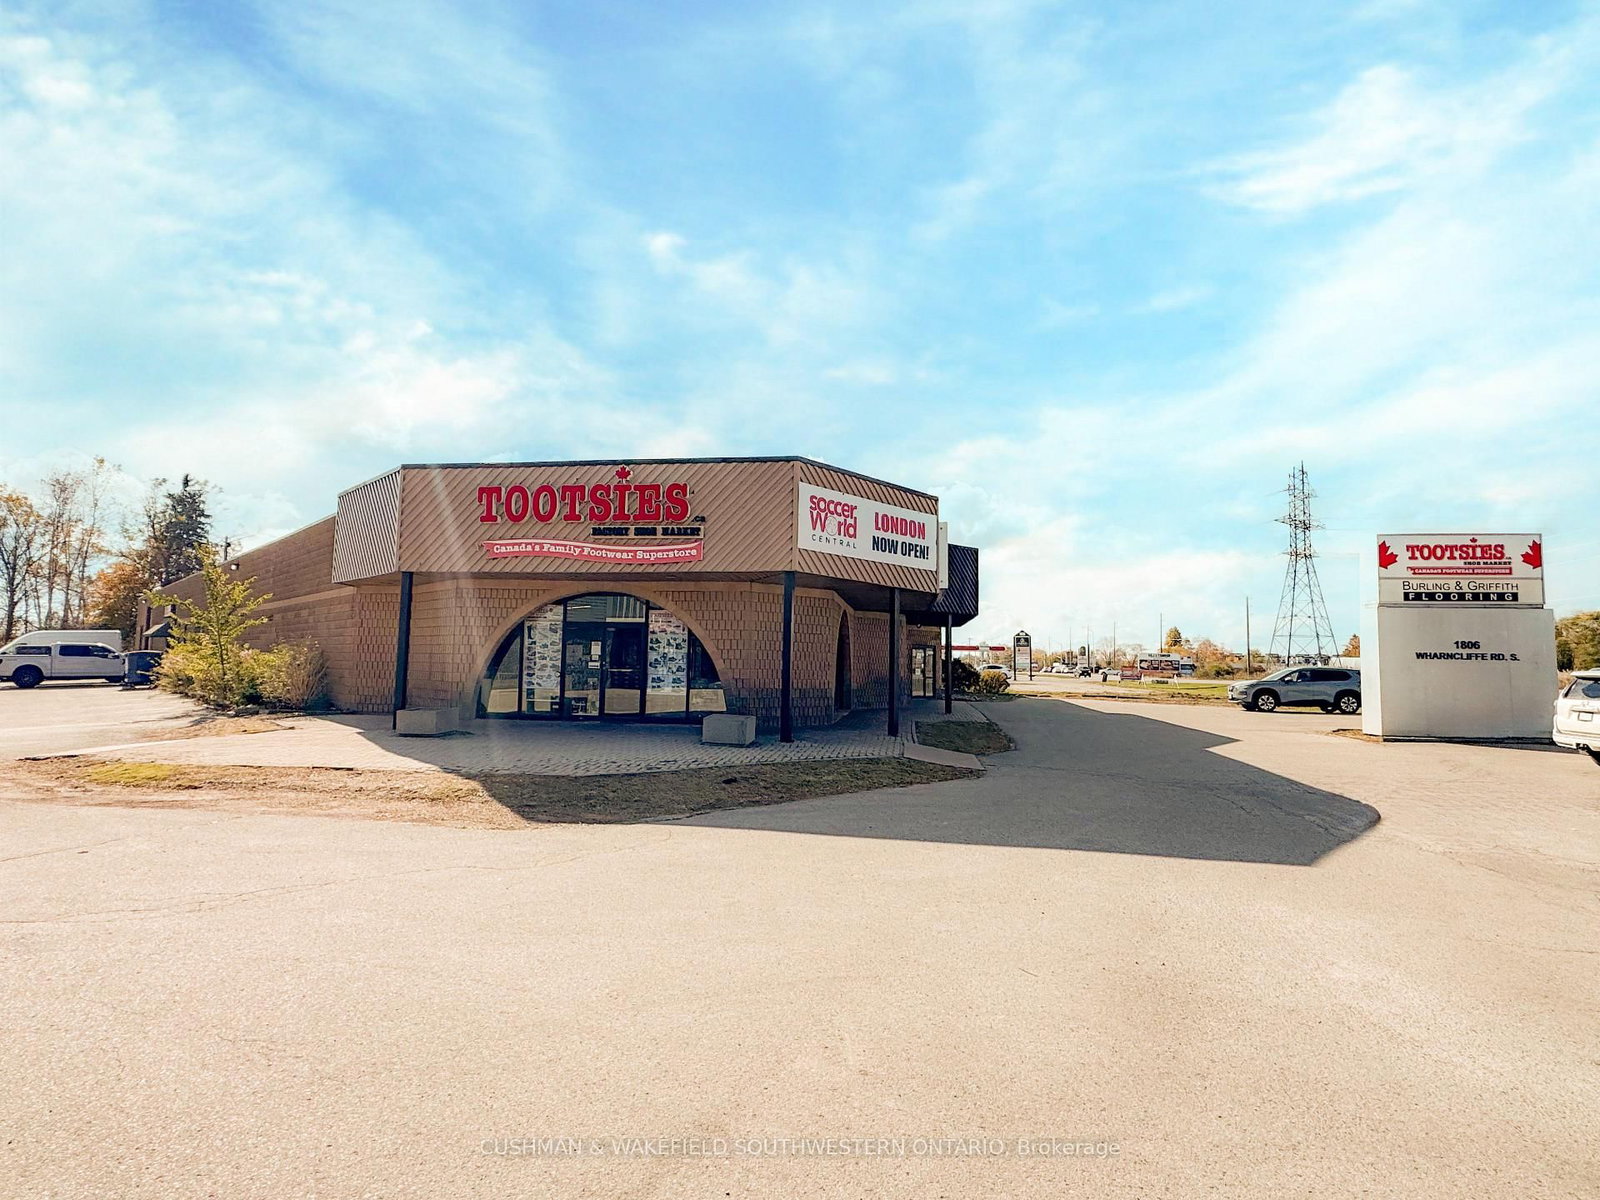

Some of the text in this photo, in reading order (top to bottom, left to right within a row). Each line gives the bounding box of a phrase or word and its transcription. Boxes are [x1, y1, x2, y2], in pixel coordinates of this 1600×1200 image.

[477, 482, 692, 524] TOOTSIES
[874, 512, 926, 540] LONDON
[811, 534, 857, 549] CENTRAL
[872, 535, 930, 560] NOW OPEN!
[493, 543, 697, 561] Canada's Family Footwear Superstore
[1406, 543, 1505, 561] TOOTSIES
[1402, 580, 1519, 591] BURLING & GRIFFITH
[1409, 593, 1513, 601] FLOORING
[1453, 640, 1481, 650] 1806
[1415, 652, 1520, 662] WHARNCLIFFE RD. S.
